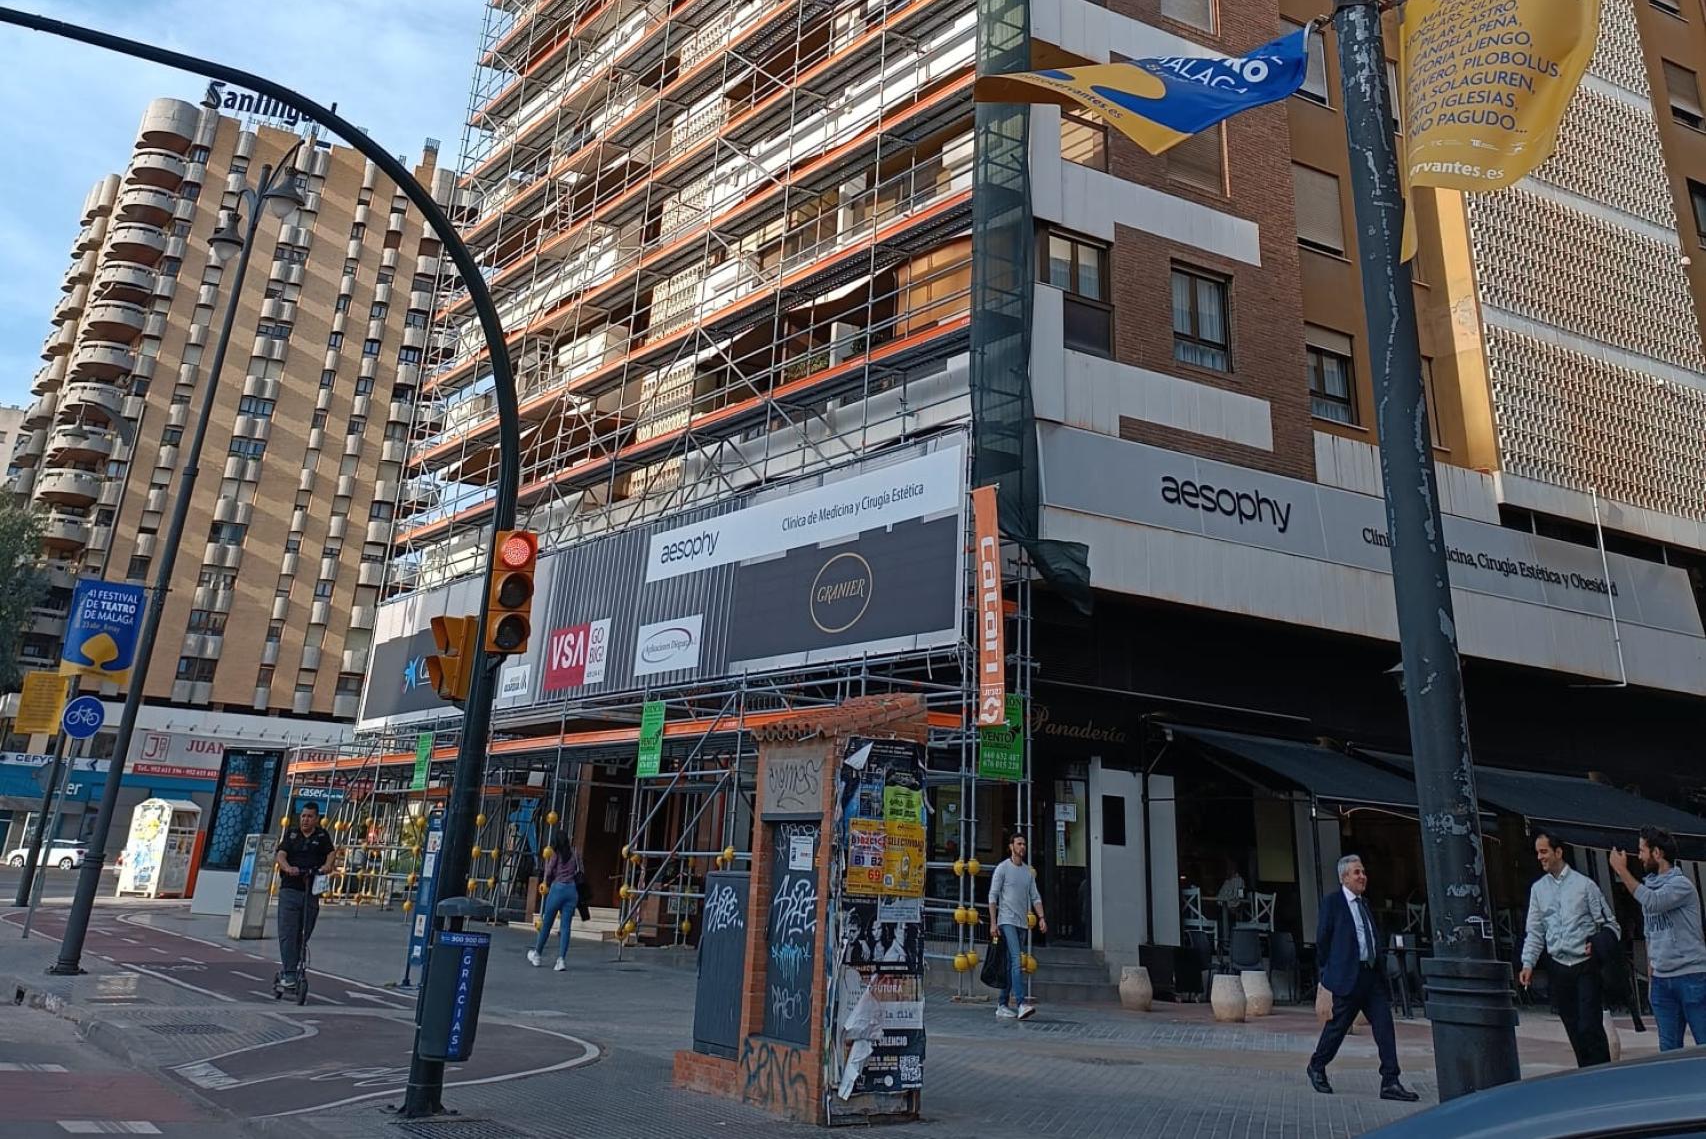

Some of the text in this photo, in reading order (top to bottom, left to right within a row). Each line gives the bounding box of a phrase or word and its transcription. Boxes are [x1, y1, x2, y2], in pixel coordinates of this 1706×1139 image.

[1419, 0, 1518, 48] PILAR CASTRO,
[1459, 31, 1533, 56] LUENGO,
[1431, 71, 1536, 97] SOLAGUREN,
[1440, 90, 1518, 111] IGLESIAS,
[1436, 110, 1528, 134] PAGUDO...
[781, 483, 924, 531] Clínica de Medicina y Cirugía Estética
[1161, 475, 1291, 533] aesophy
[661, 530, 720, 564] aesophy
[1362, 527, 1391, 548] Clíni
[1477, 553, 1518, 577] Cirugía
[1519, 562, 1562, 585] Estética
[1563, 574, 1569, 589] y
[98, 590, 138, 604] FESTIVAL
[817, 578, 865, 605] GRANIER
[84, 610, 96, 619] DE
[86, 599, 136, 614] DE TEATRO
[591, 626, 604, 644] GO
[1030, 703, 1128, 743] Panadería
[299, 787, 325, 798] caser
[450, 955, 472, 1045] GRACIAS
